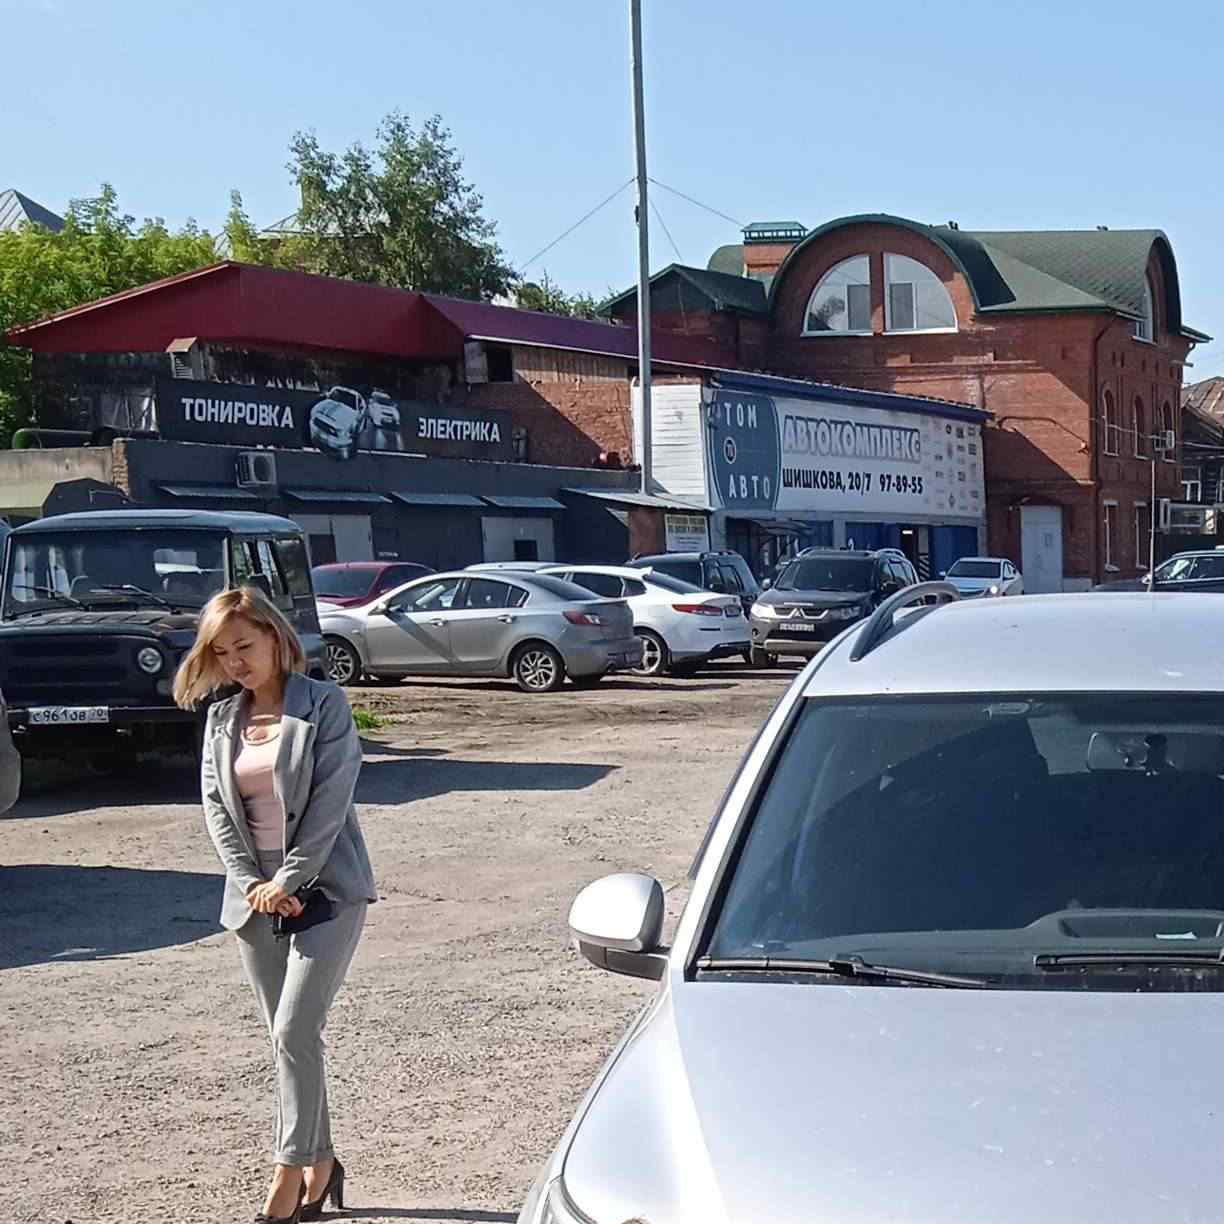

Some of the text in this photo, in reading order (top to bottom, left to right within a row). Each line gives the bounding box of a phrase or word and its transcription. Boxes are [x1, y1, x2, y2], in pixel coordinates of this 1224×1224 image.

[181, 397, 295, 429] ТОНИРОВКА
[723, 402, 758, 429] ТОМ
[417, 416, 501, 442] ЭЛЕКТРИКА
[783, 414, 921, 463] АВТОКОМПЛЕКС
[728, 474, 771, 499] АВТО
[782, 468, 924, 496] ШИШКОВА, 20/7 97-89-55
